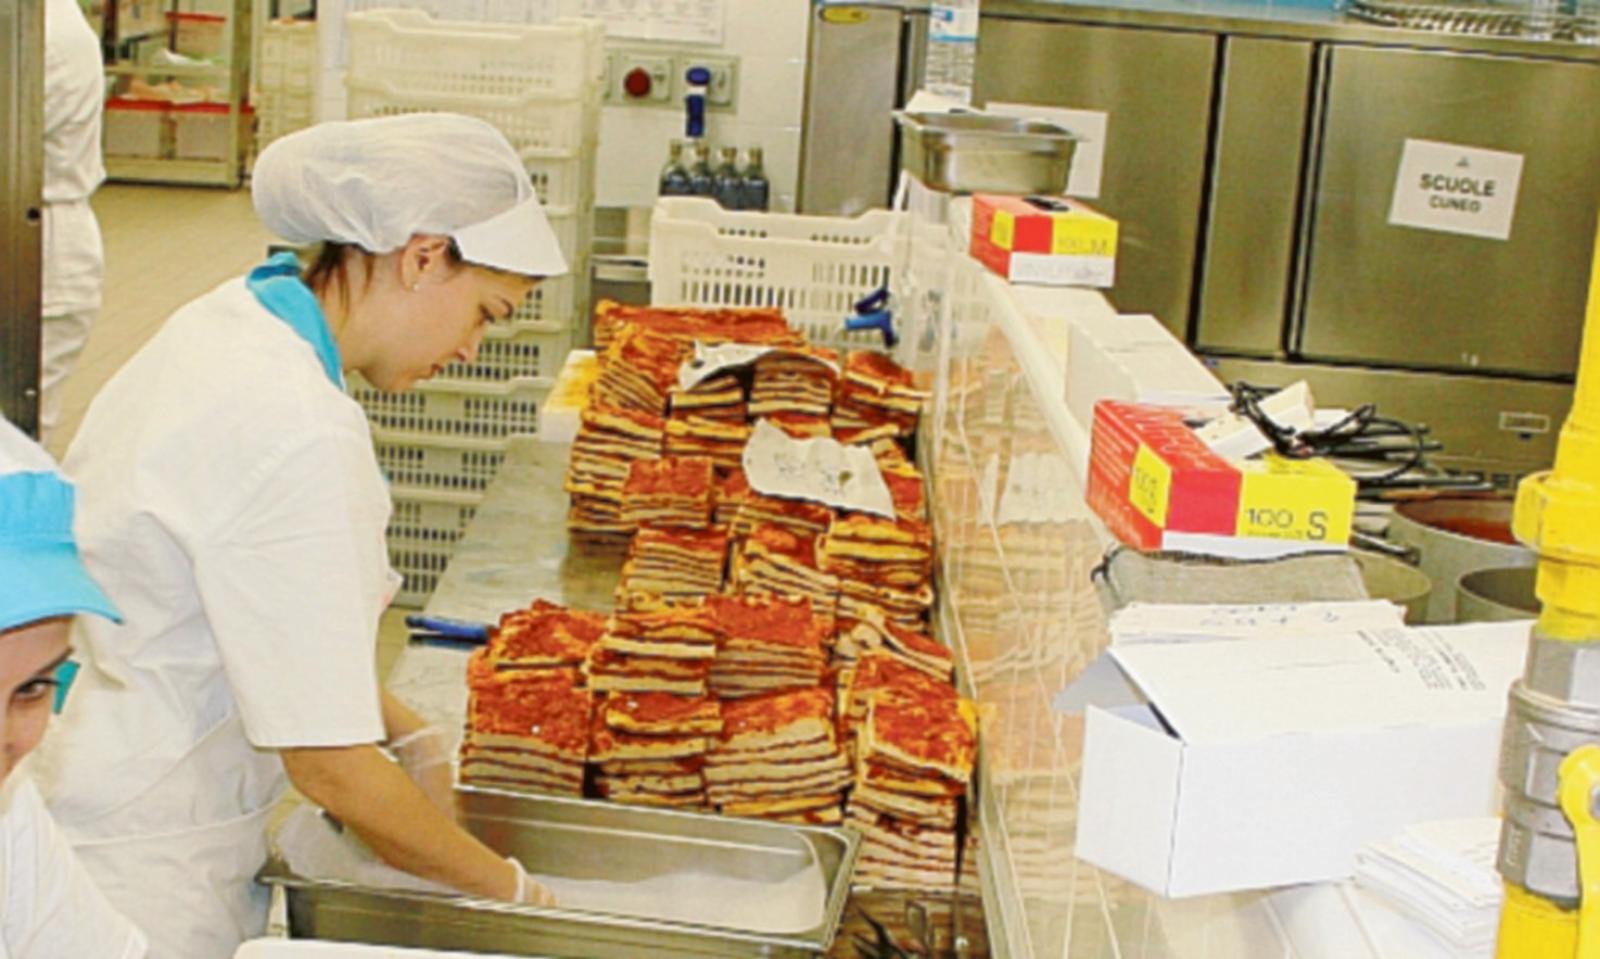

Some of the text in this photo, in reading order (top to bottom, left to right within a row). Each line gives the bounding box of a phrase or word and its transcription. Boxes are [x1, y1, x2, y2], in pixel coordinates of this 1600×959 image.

[1419, 173, 1496, 197] SCUOLE
[1428, 195, 1482, 213] CUNEO
[1249, 508, 1329, 541] 100 S
